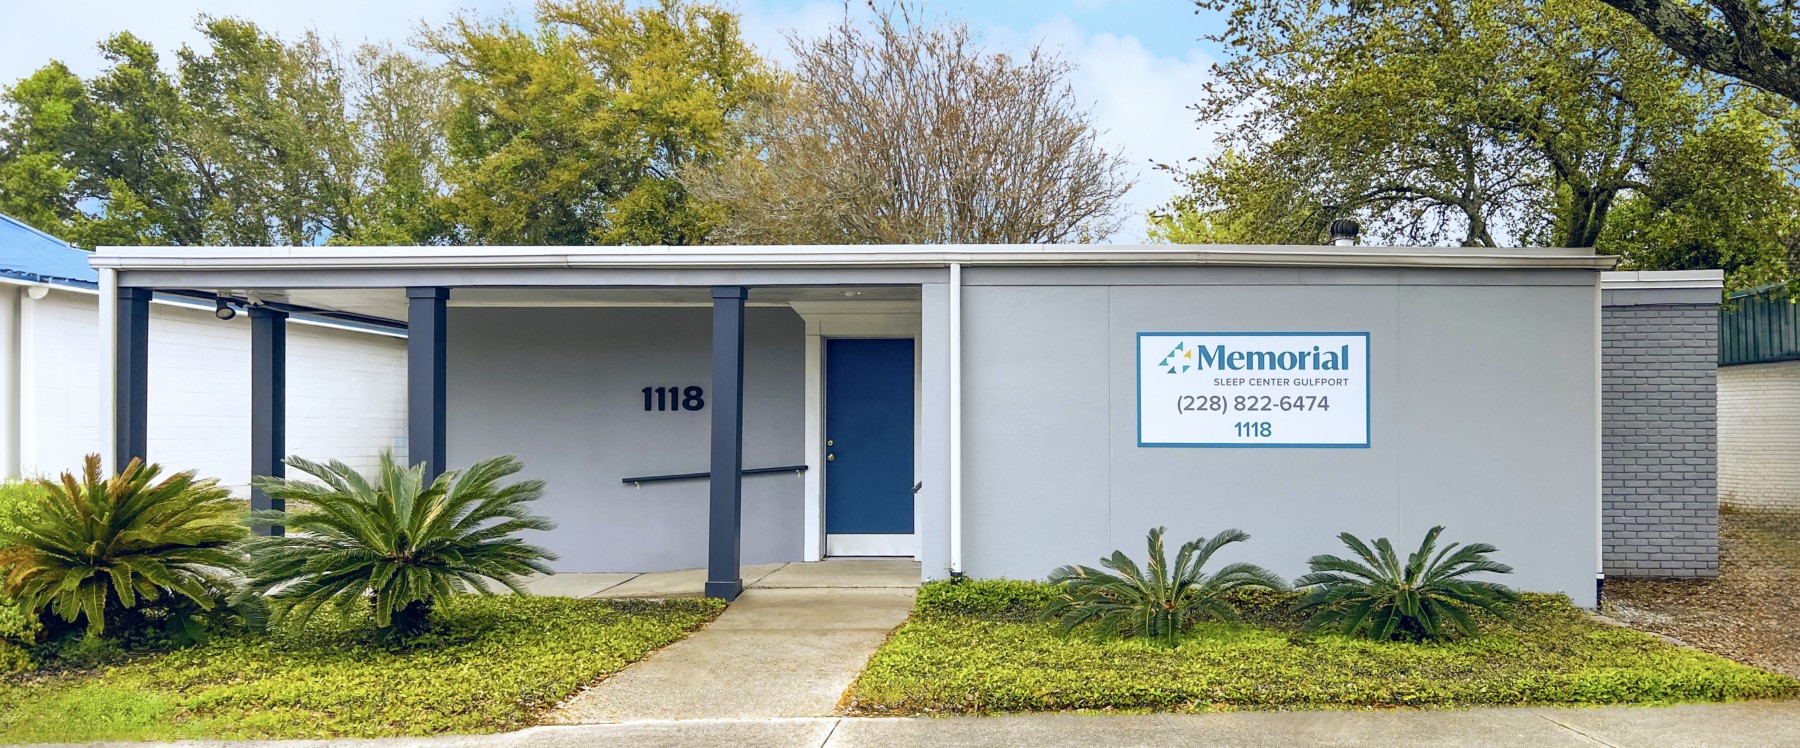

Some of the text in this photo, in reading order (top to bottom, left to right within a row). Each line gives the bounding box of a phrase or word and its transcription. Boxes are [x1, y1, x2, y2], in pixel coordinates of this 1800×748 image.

[1197, 344, 1349, 371] Memorial
[1213, 377, 1349, 387] SLEEP CENTER GULFPORT
[641, 385, 705, 412] 1118
[1177, 395, 1330, 415] (228) 822-6474
[1234, 421, 1272, 438] 1118
